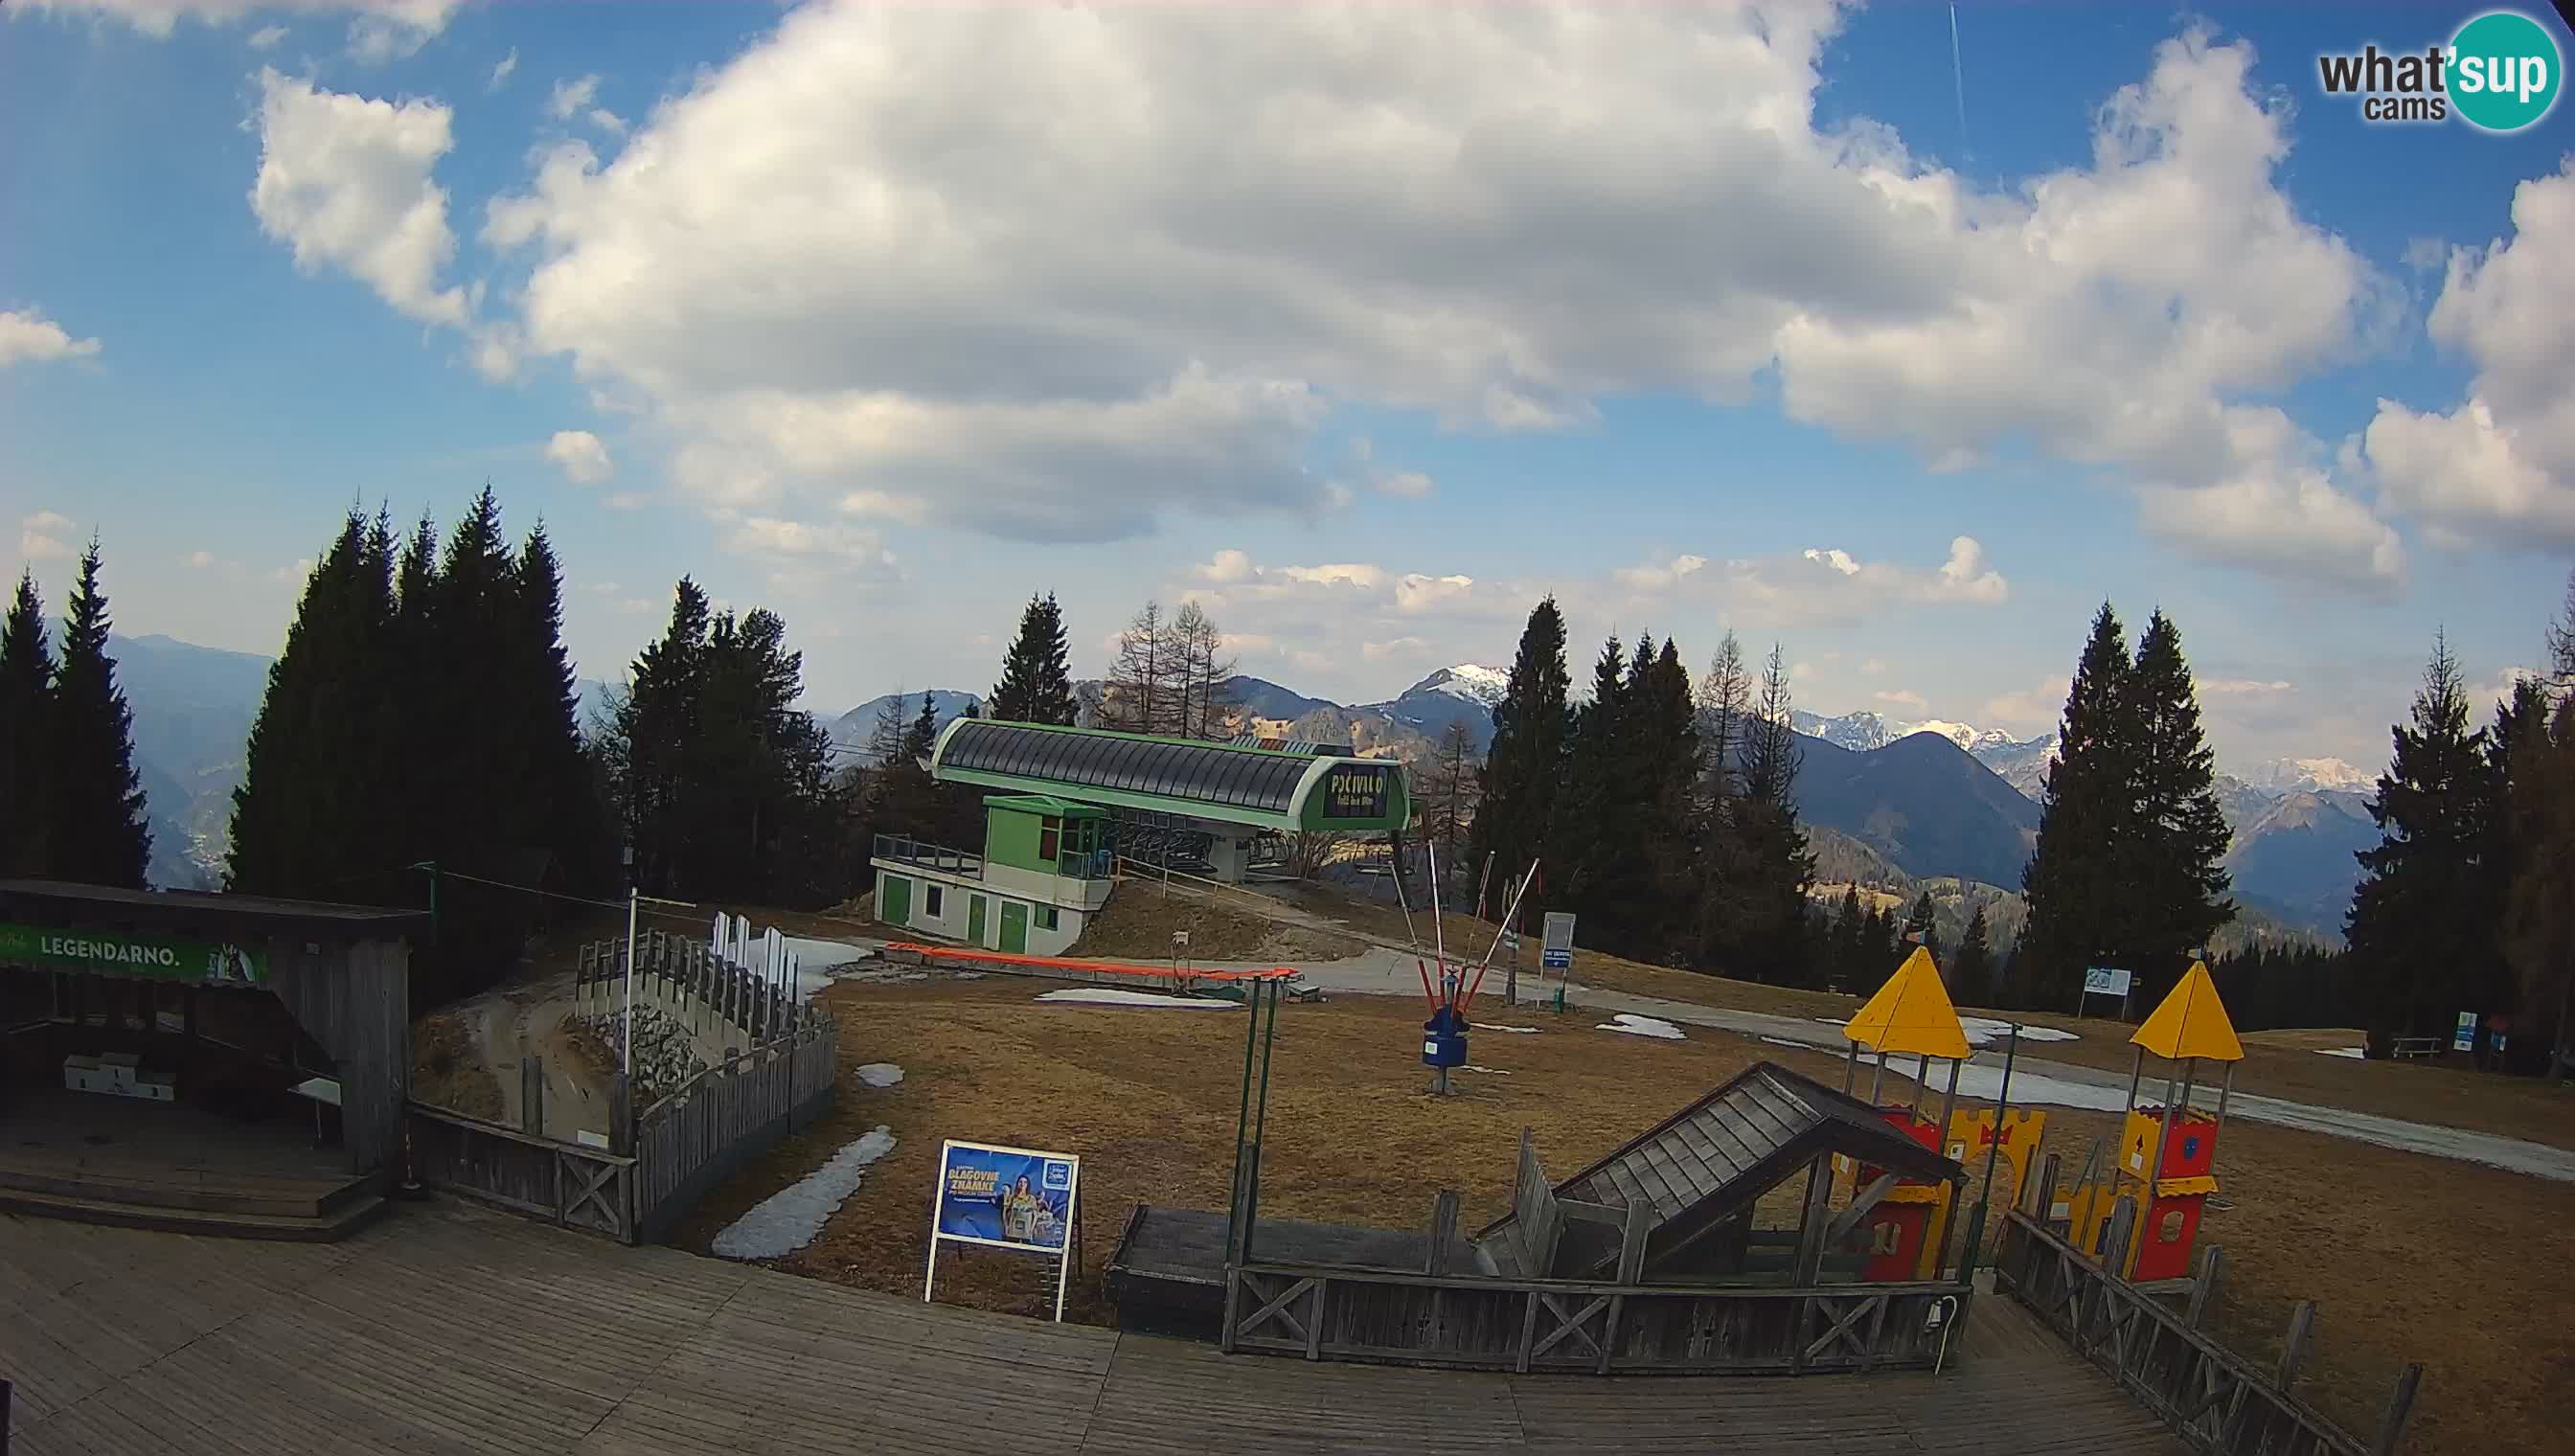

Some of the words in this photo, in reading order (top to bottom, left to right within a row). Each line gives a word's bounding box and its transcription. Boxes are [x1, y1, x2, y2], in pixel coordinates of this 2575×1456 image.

[40, 936, 180, 967] LEGENDARNO.
[948, 1170, 999, 1180] BLAGOVNE
[950, 1180, 995, 1191] ZNAMKE
